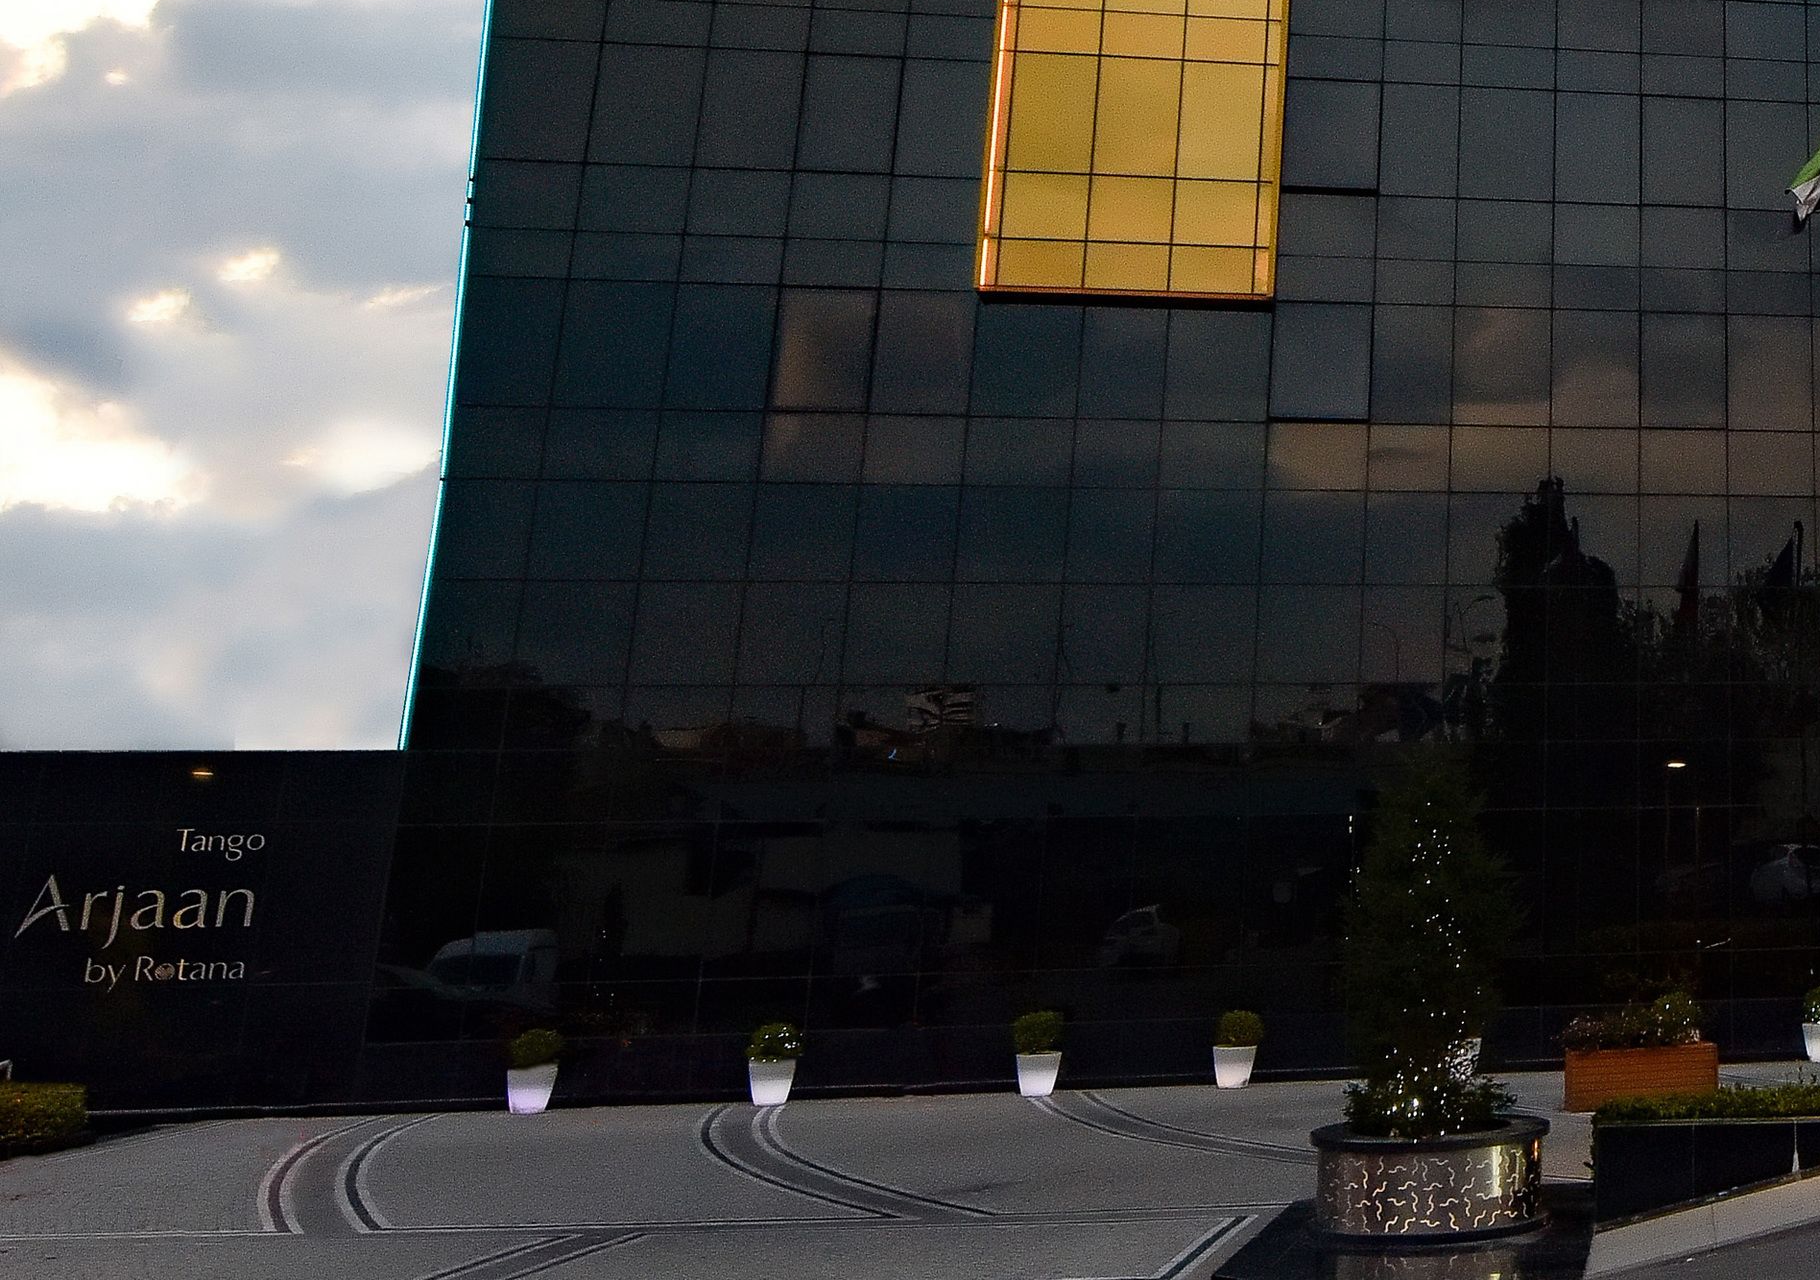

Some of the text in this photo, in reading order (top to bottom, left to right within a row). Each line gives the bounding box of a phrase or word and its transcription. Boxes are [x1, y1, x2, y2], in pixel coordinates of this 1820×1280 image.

[176, 828, 266, 861] Tango
[14, 874, 256, 950] Arjaan
[84, 956, 246, 993] by Rotana
